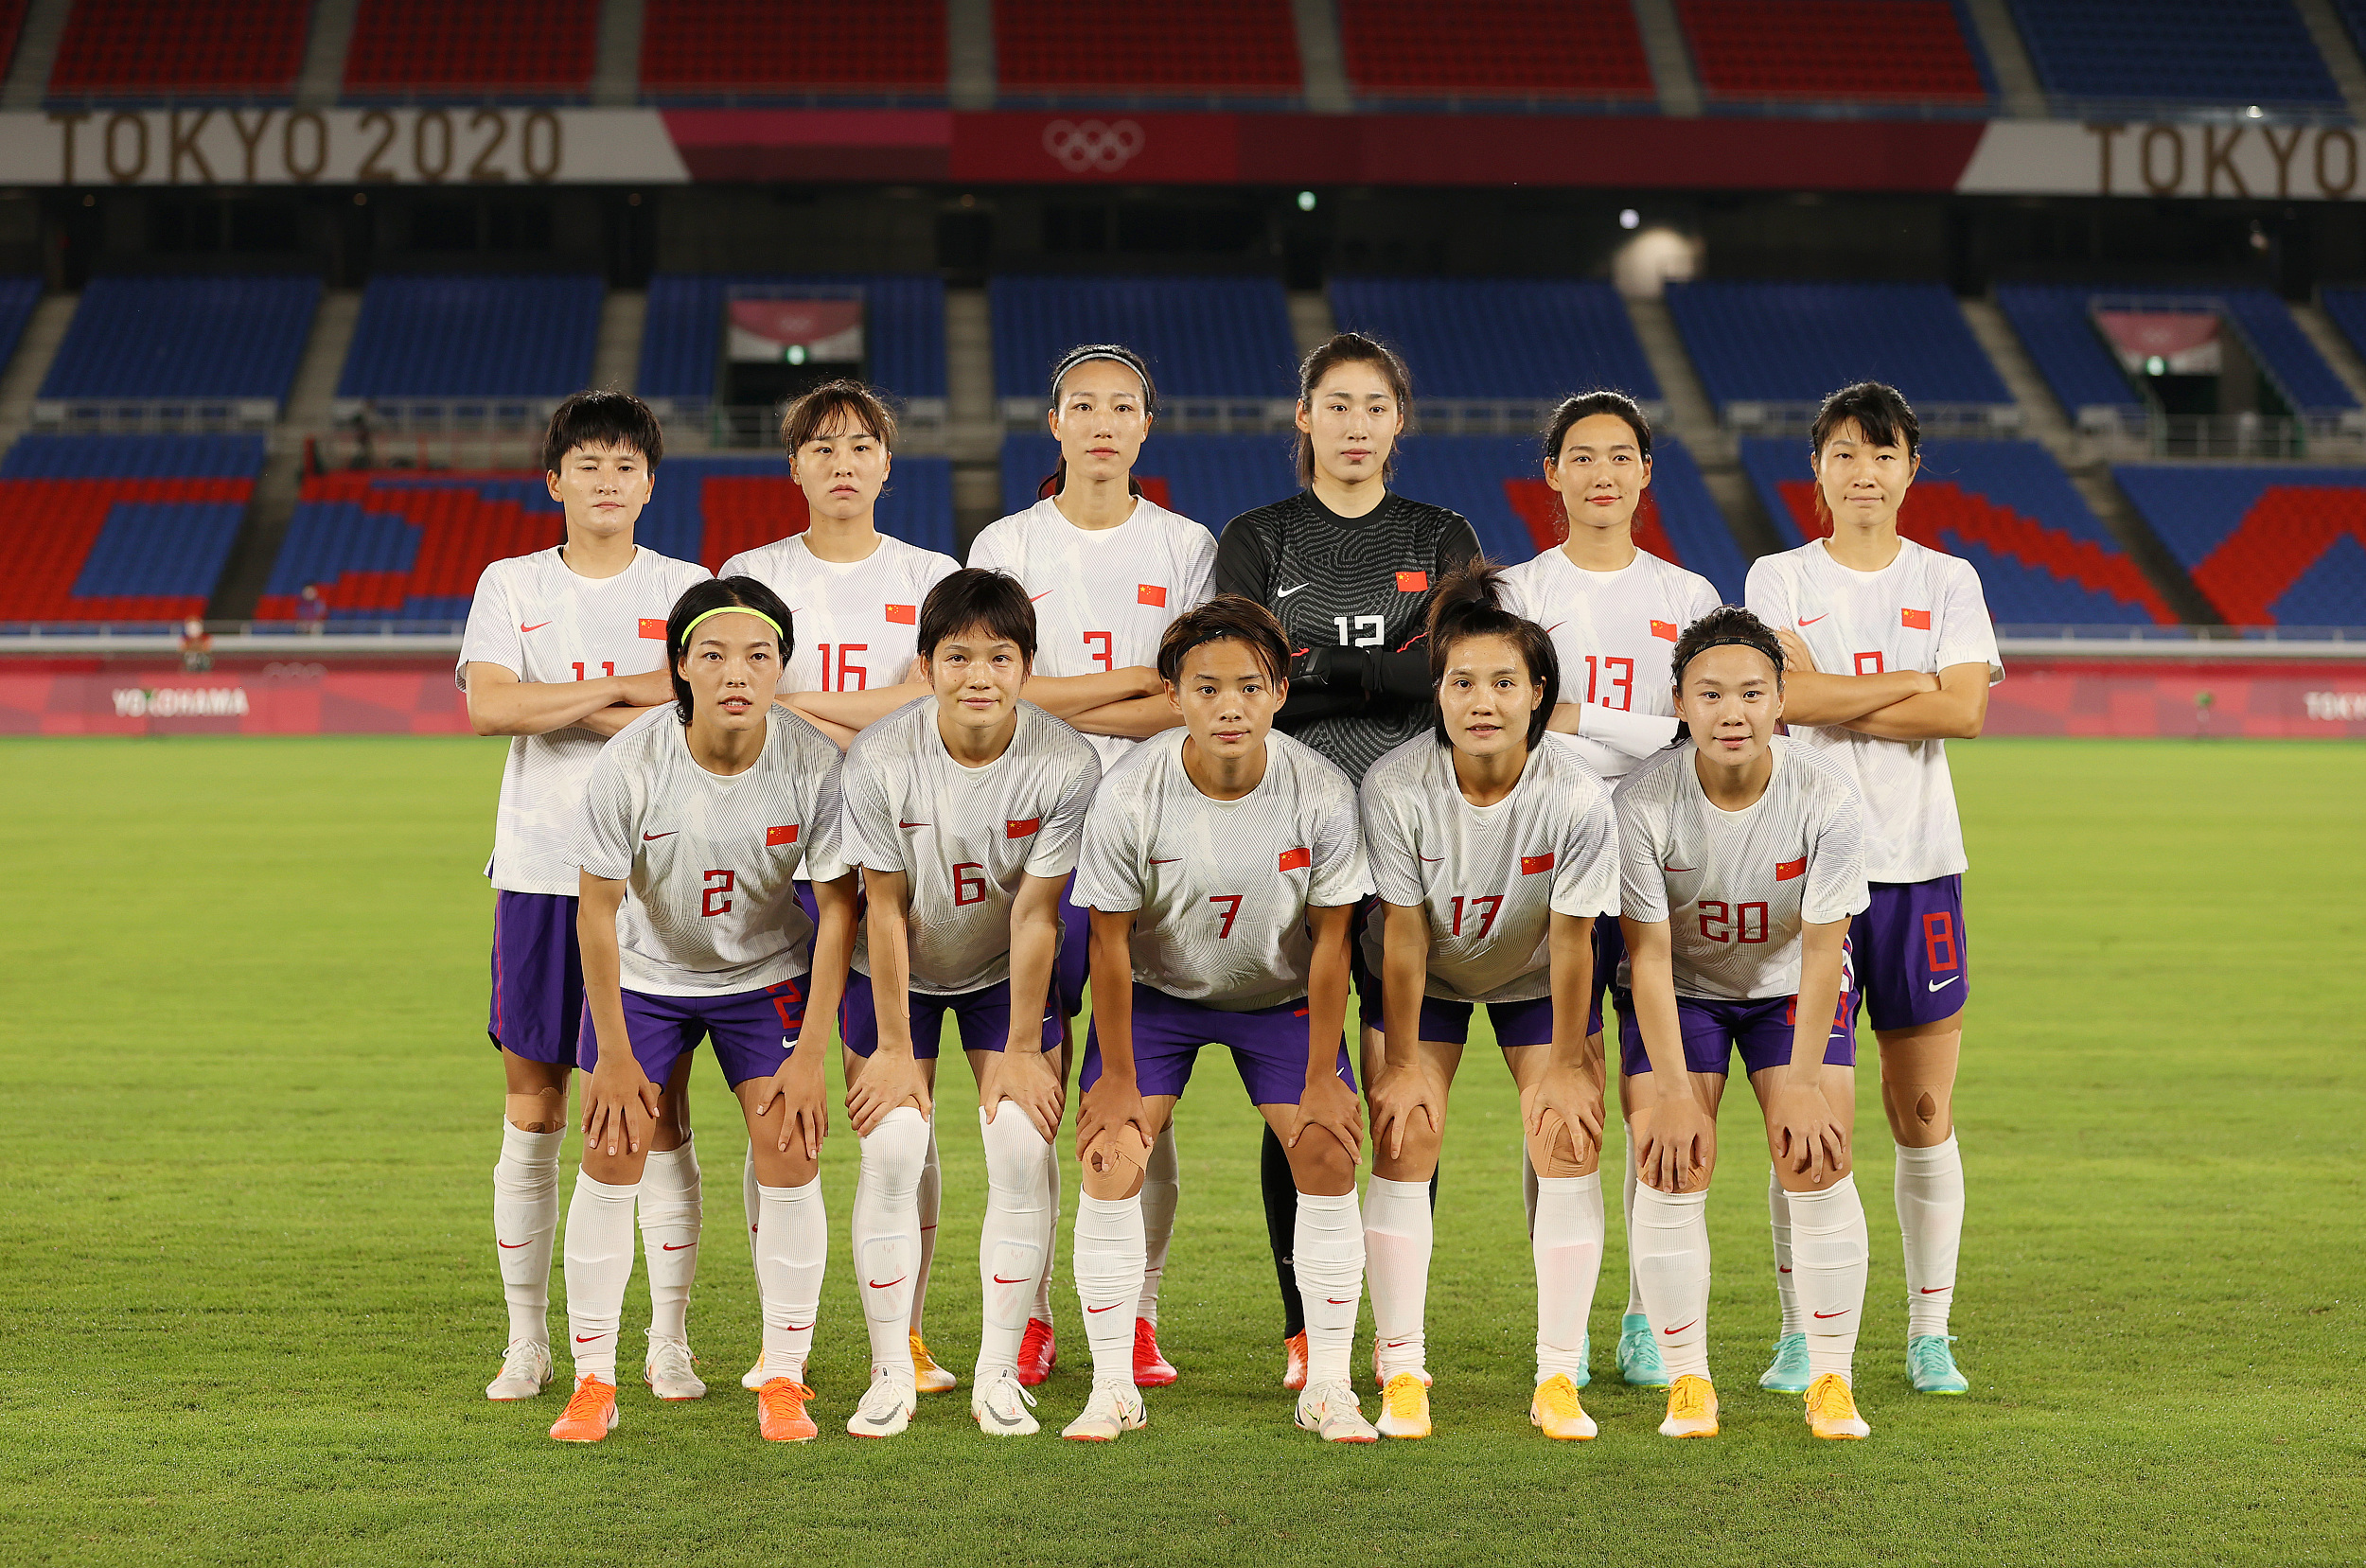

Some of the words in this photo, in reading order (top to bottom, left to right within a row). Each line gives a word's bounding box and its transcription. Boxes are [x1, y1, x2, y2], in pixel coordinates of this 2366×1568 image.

[47, 108, 328, 183] TOKYO
[354, 110, 562, 183] 2020
[2084, 123, 2358, 197] TOKYO
[819, 643, 868, 692] 16
[1083, 631, 1113, 674] 3
[1585, 656, 1633, 712] 13
[701, 870, 734, 917] 2
[953, 862, 986, 907] 6
[1209, 895, 1244, 939] 7
[1451, 895, 1504, 939] 17
[1699, 901, 1769, 943] 20
[1923, 911, 1958, 973] 8
[765, 979, 804, 1029] 2
